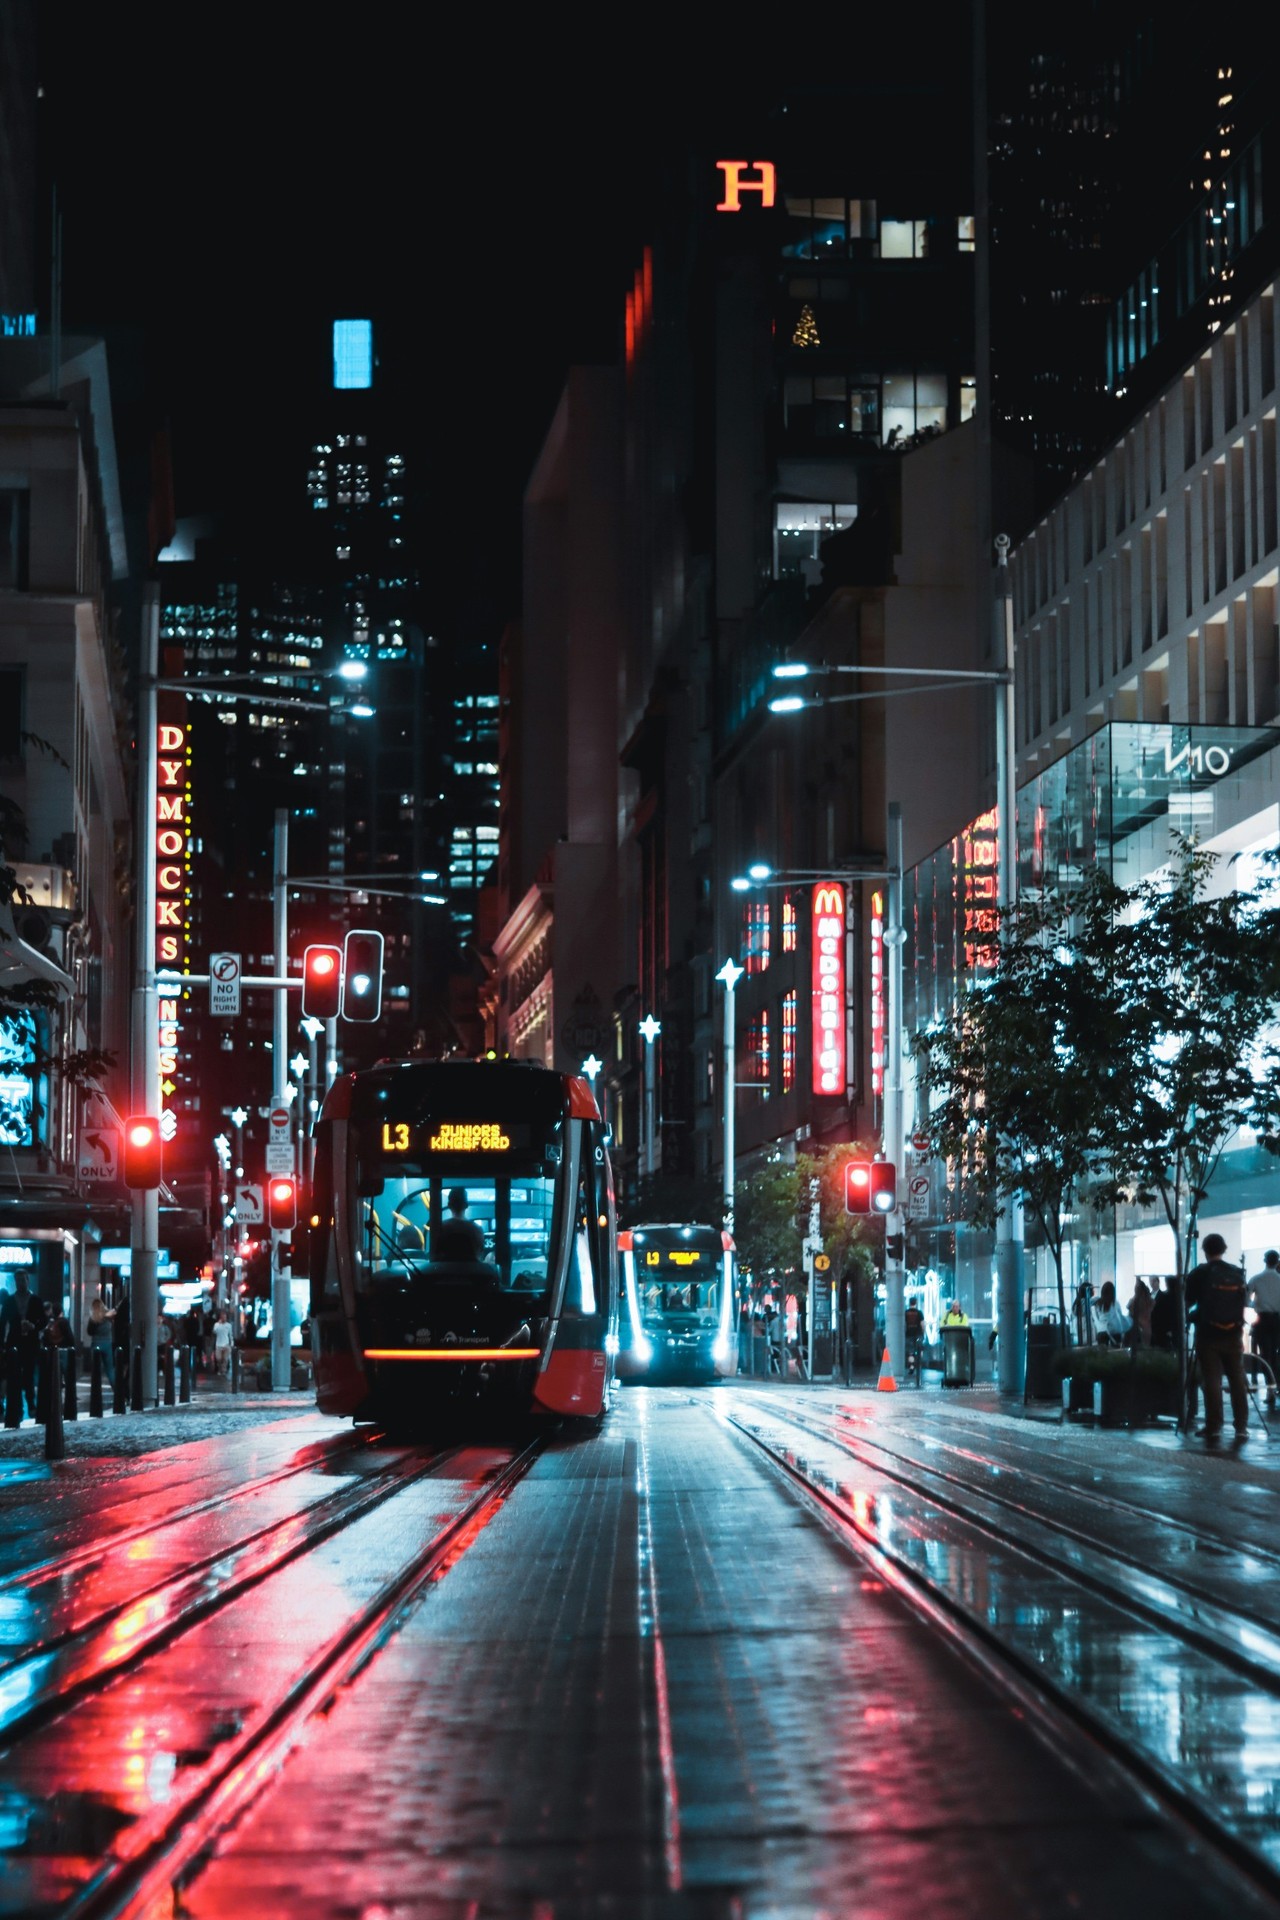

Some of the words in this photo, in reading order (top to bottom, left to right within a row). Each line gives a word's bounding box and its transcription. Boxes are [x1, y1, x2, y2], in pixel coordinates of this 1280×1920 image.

[716, 161, 776, 212] H
[158, 725, 184, 962] DYMOCKS
[217, 984, 233, 994] NO
[213, 995, 237, 1003] RIGHT
[214, 1004, 236, 1012] TURN
[440, 1124, 501, 1138] JUNIORS
[383, 1123, 410, 1151] L3
[430, 1136, 510, 1150] KINGSFORD
[81, 1167, 114, 1177] ONLY
[914, 1196, 925, 1204] NO
[238, 1212, 261, 1221] ONLY
[646, 1251, 660, 1266] L3
[458, 1336, 490, 1344] Transport
